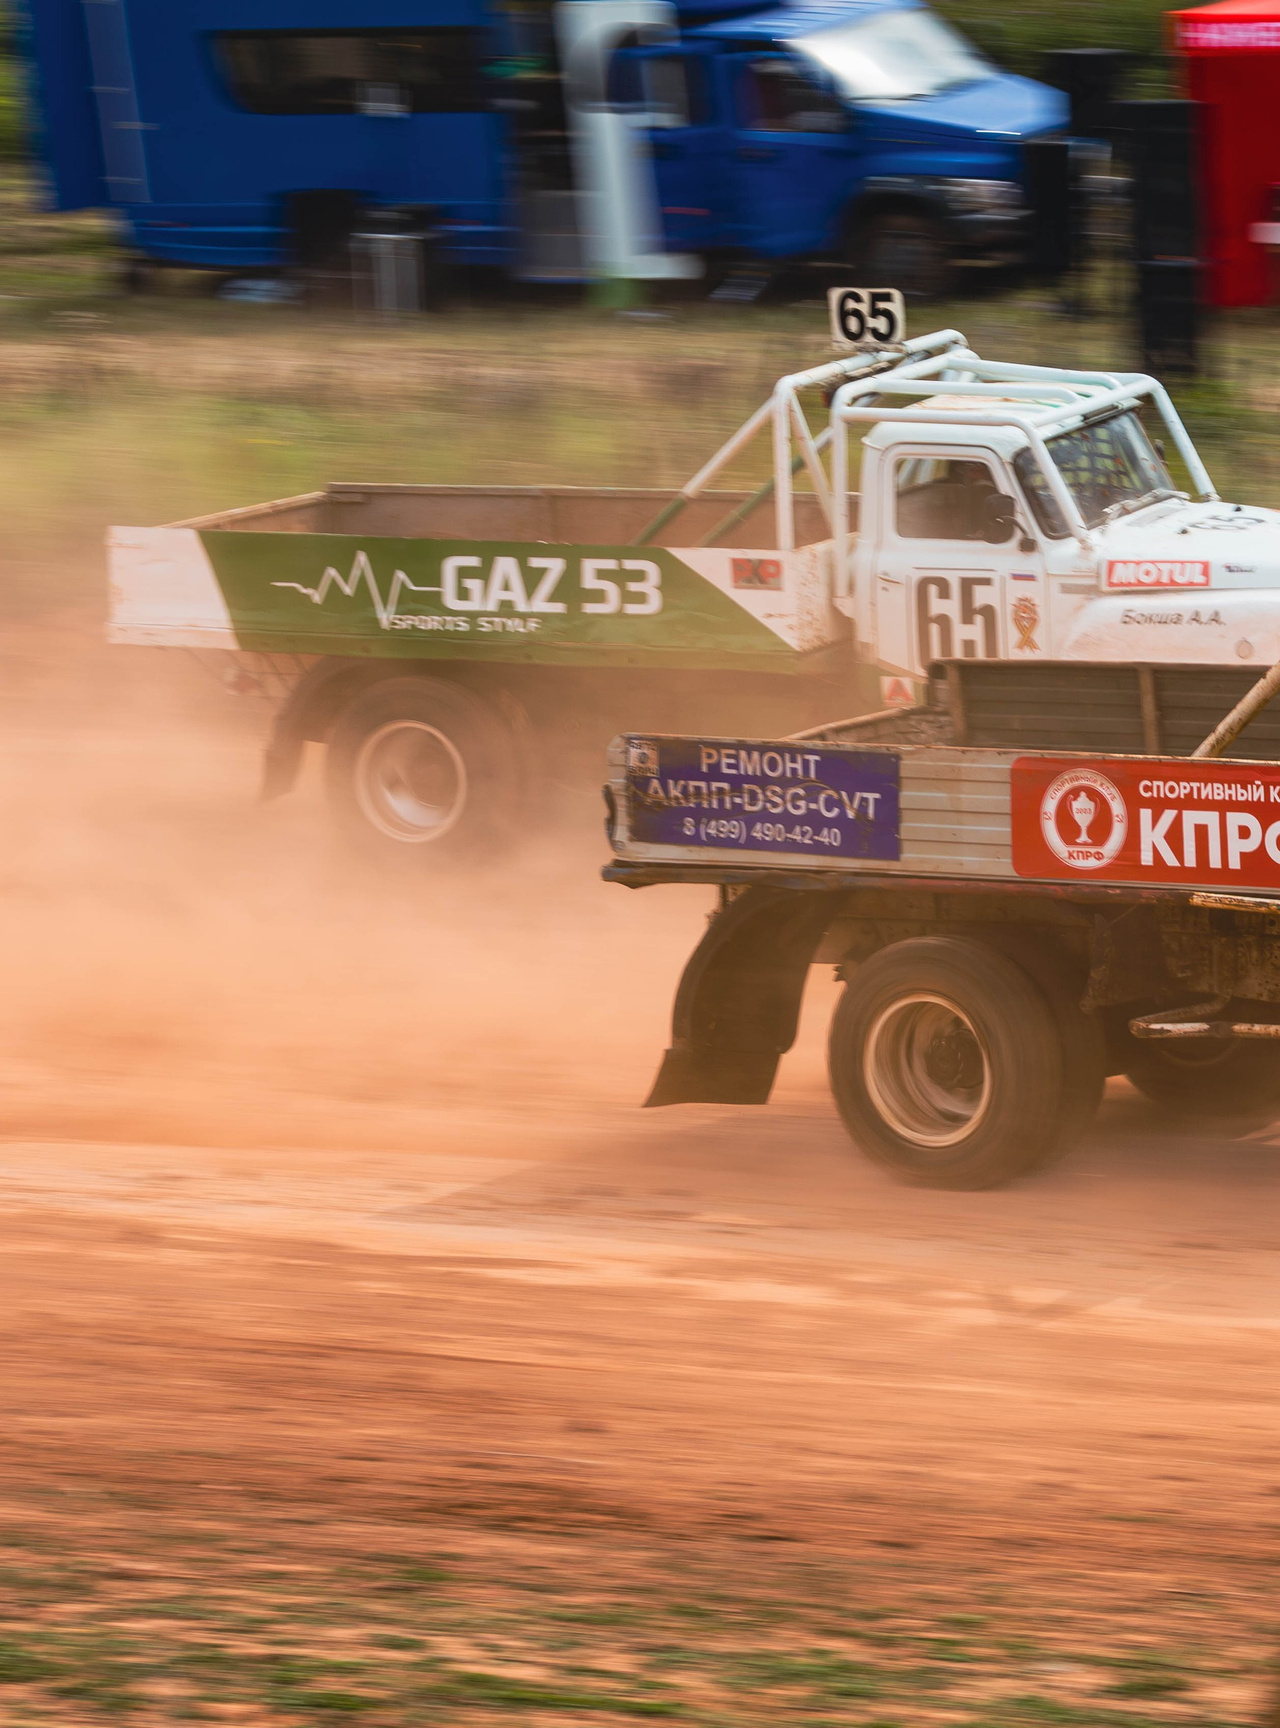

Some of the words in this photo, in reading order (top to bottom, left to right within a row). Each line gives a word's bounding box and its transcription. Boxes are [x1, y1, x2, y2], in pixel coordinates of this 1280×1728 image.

[838, 290, 897, 343] 65
[441, 556, 566, 613] GAZ
[580, 557, 663, 615] 53
[1110, 562, 1207, 584] MOTUL
[390, 615, 470, 631] SPORTS
[477, 617, 542, 633] STYLE
[916, 576, 998, 669] 65
[1120, 609, 1184, 625] Бокша
[700, 745, 821, 780] РЕМОНТ
[646, 779, 881, 820] АКПП-DSG-CVT
[1138, 780, 1265, 802] СПОРТИВНЫЙ
[682, 817, 695, 836] 8
[700, 817, 747, 844] (499)
[751, 821, 841, 846] 490-42-40
[1067, 849, 1105, 862] КПРФ
